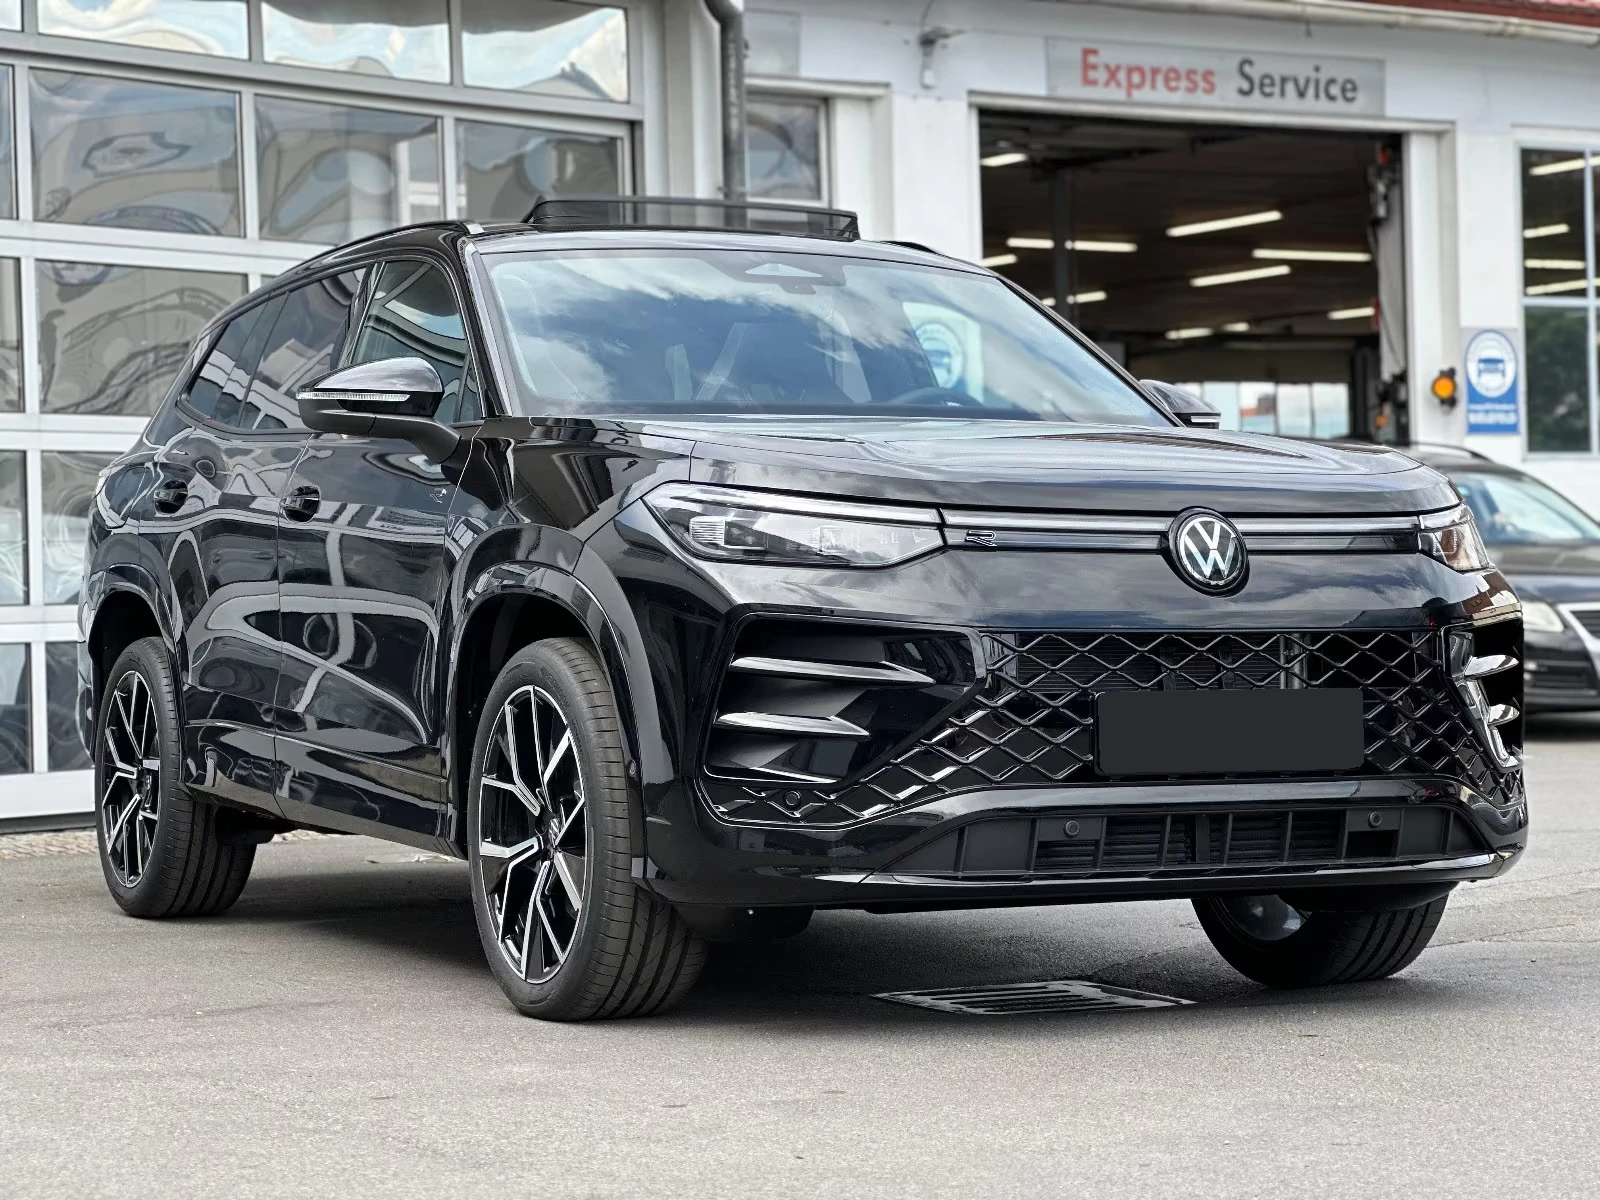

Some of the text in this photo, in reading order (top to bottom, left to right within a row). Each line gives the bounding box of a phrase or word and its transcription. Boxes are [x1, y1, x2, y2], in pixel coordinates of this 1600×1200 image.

[1081, 47, 1359, 103] Express Service
[1181, 517, 1240, 583] VW
